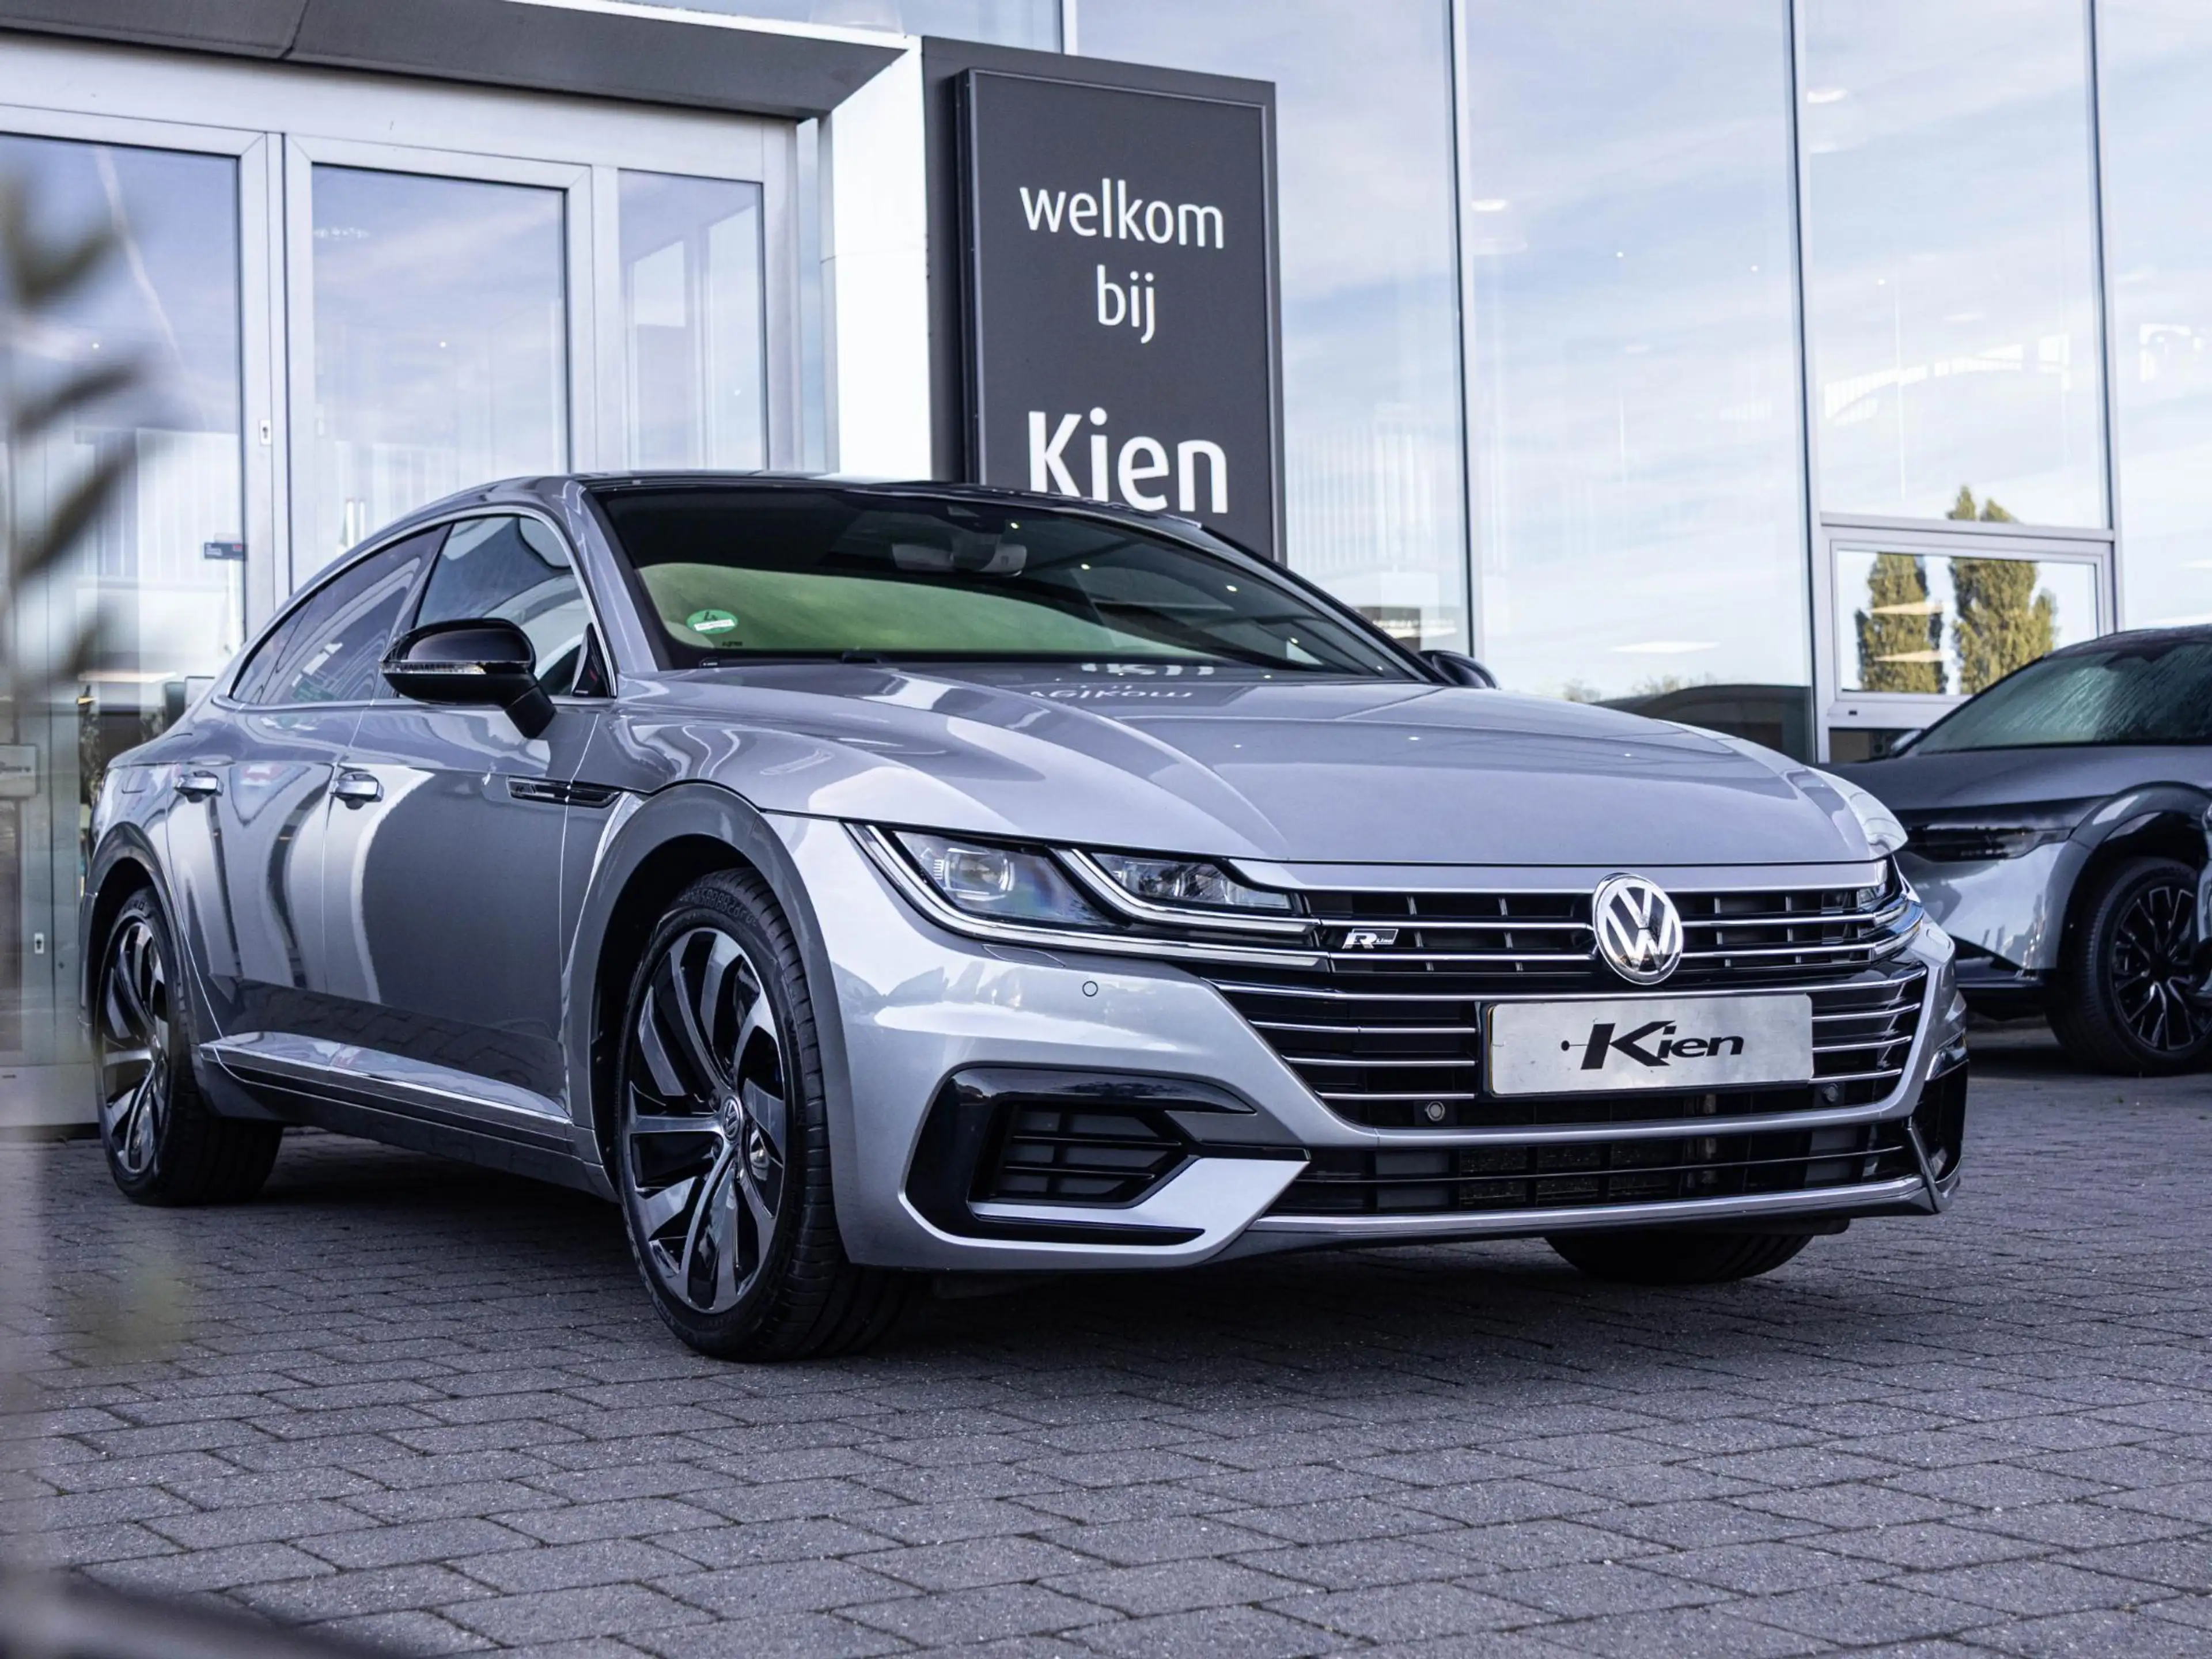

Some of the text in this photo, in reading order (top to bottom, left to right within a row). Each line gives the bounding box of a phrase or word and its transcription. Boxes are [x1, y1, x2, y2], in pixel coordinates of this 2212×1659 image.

[1020, 178, 1224, 249] welkom
[1097, 264, 1156, 344] bij
[1028, 407, 1228, 513] Kien
[1580, 1020, 1744, 1070] Kien
